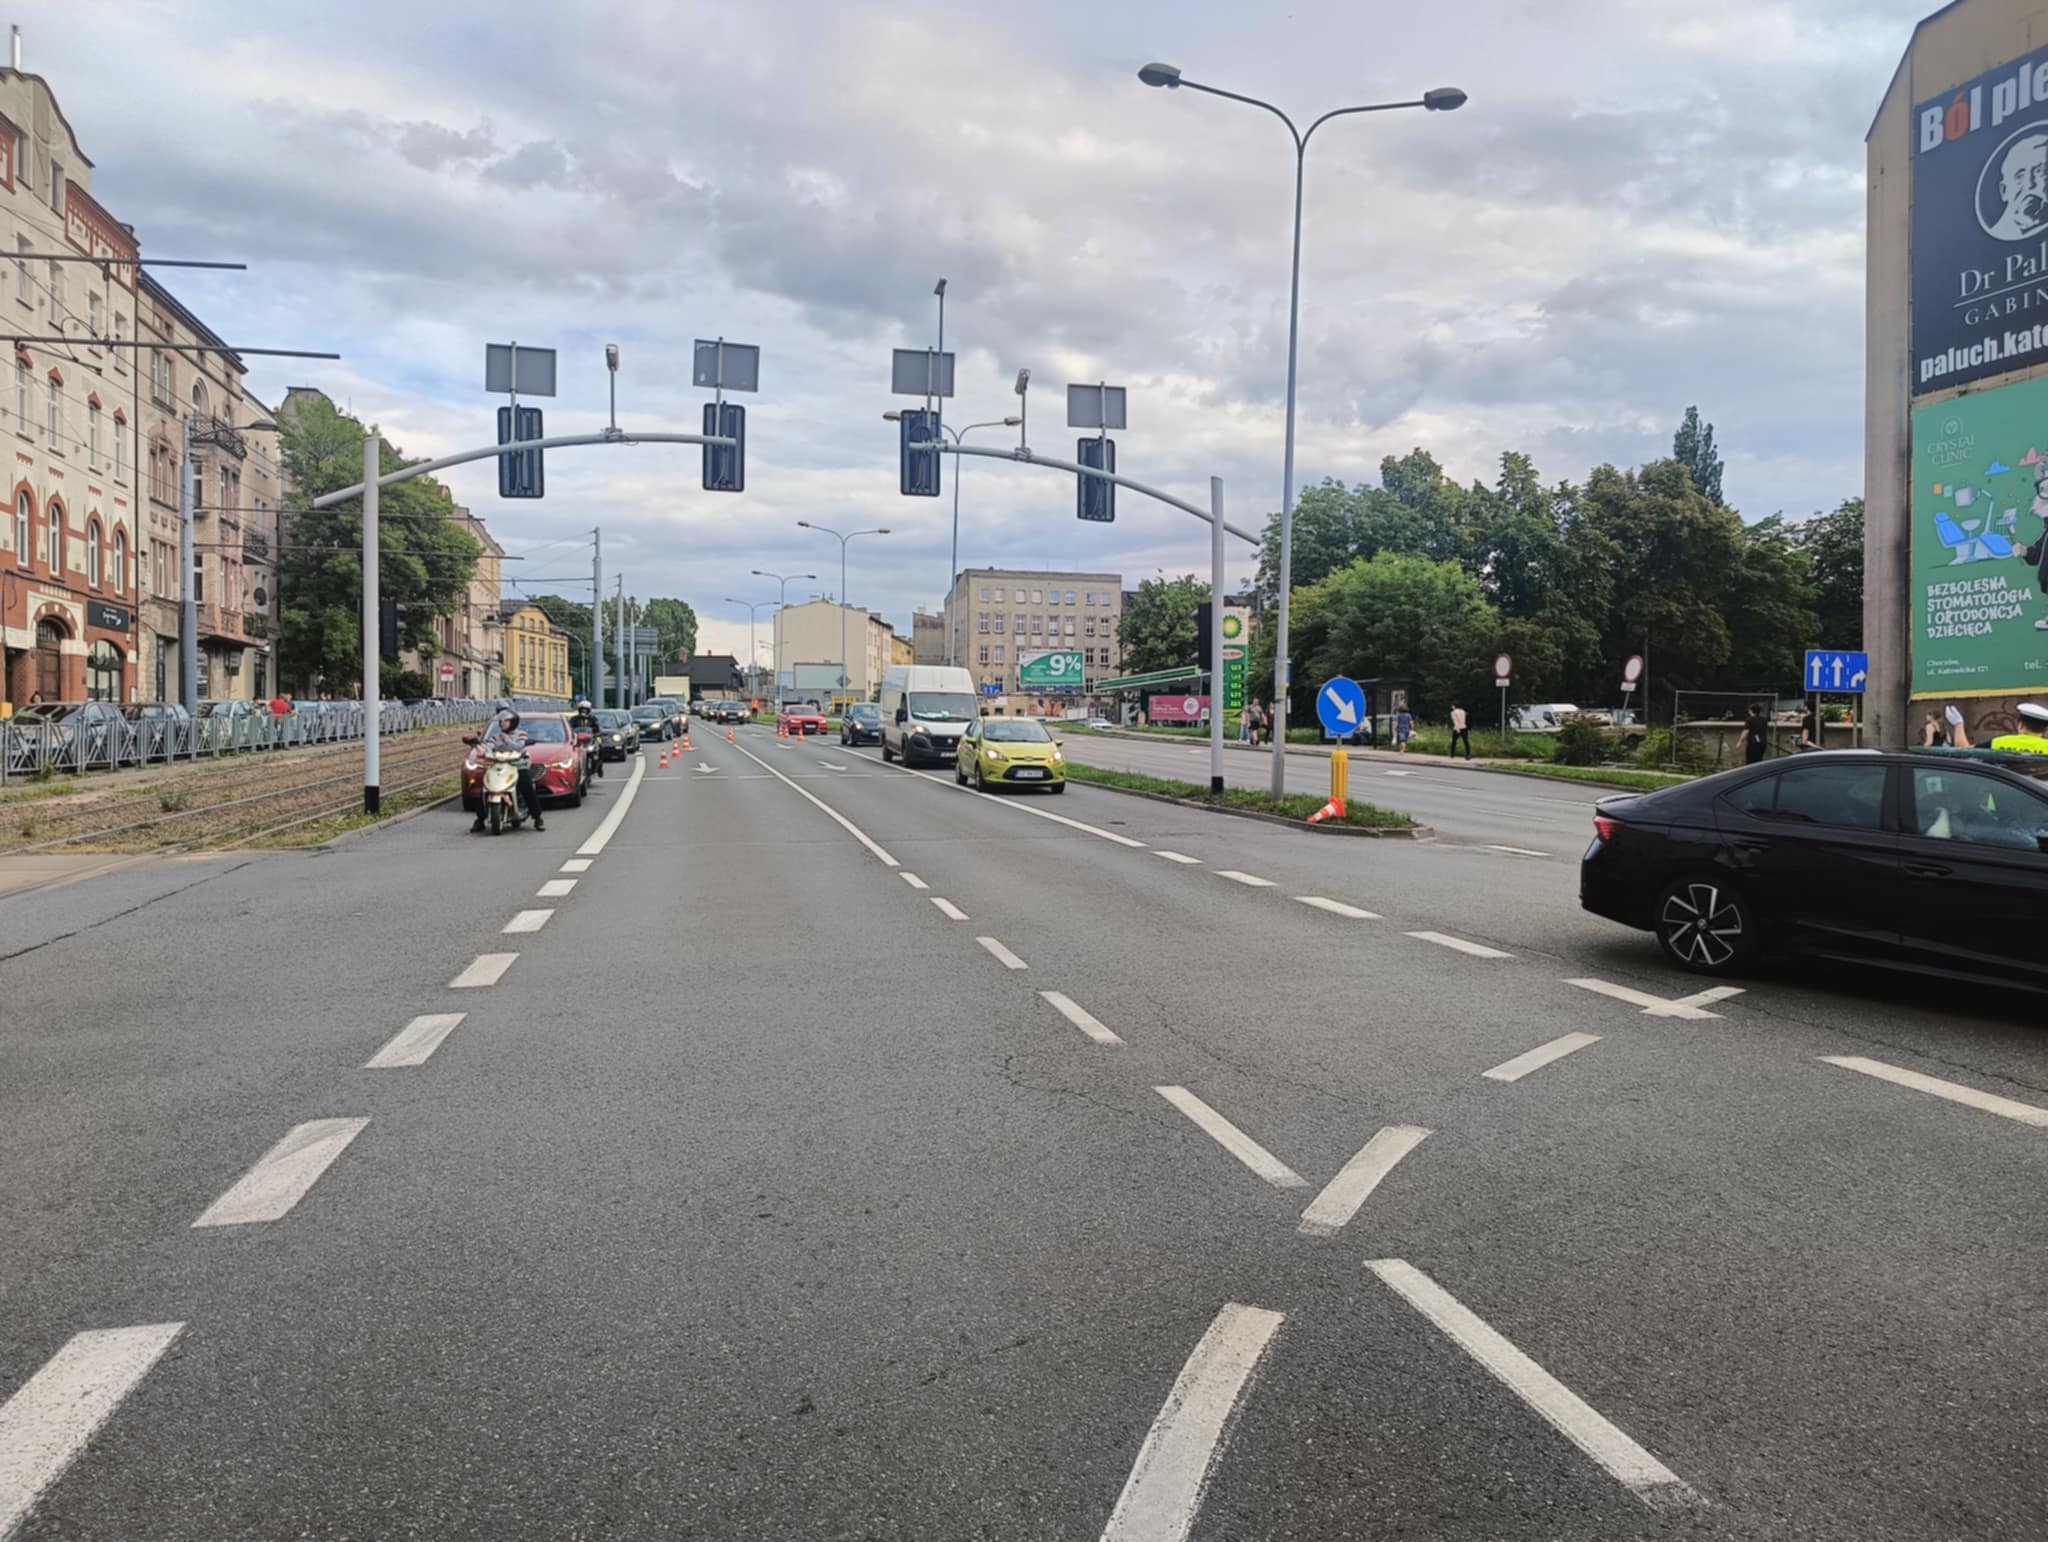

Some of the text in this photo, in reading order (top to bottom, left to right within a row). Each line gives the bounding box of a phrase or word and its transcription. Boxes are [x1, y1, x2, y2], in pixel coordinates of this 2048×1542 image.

[1960, 241, 2048, 298] Dr Pal
[1964, 289, 2048, 325] GABIN
[1927, 433, 1977, 454] CRYSTAL
[1931, 448, 1970, 465] CLINIC
[1927, 576, 2007, 598] BEZBOLESNA
[1927, 588, 2032, 612] STOMATOLOGIA
[1927, 603, 2023, 625] I ORTODONCJA
[1927, 621, 1993, 638] DZIECIĘCA
[1049, 654, 1081, 676] 9%
